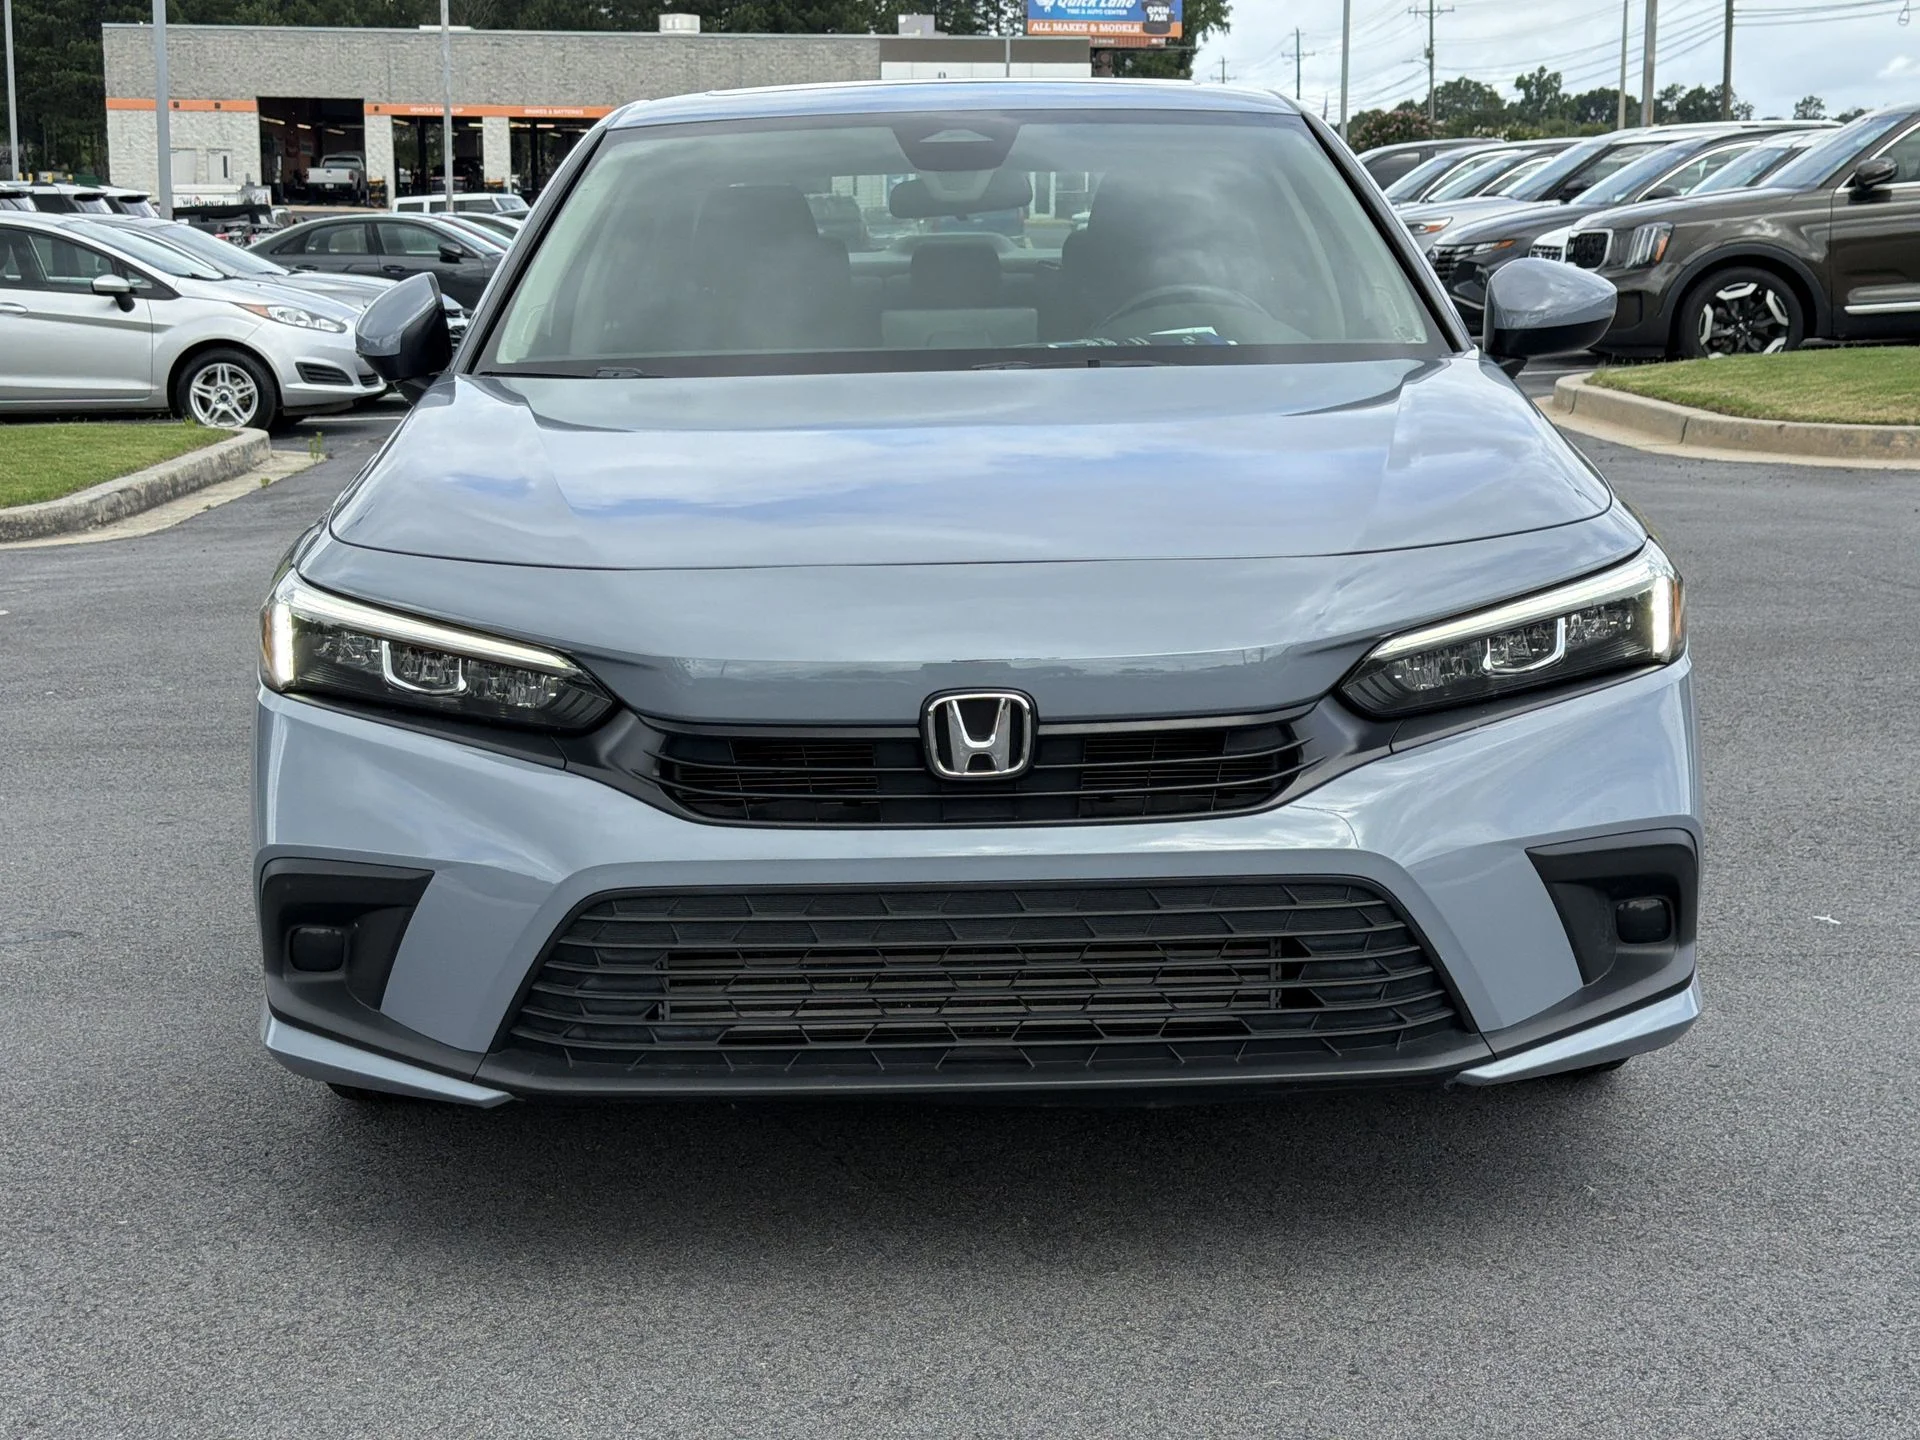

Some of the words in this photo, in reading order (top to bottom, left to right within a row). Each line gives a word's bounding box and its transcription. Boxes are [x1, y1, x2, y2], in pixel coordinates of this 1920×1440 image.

[1057, 0, 1097, 8] Quick
[1099, 0, 1136, 8] Lane
[1147, 6, 1170, 14] OPEN
[1032, 23, 1051, 31] ALL
[1053, 23, 1088, 32] MAKES
[1090, 24, 1097, 32] &
[1099, 24, 1140, 33] MODELS
